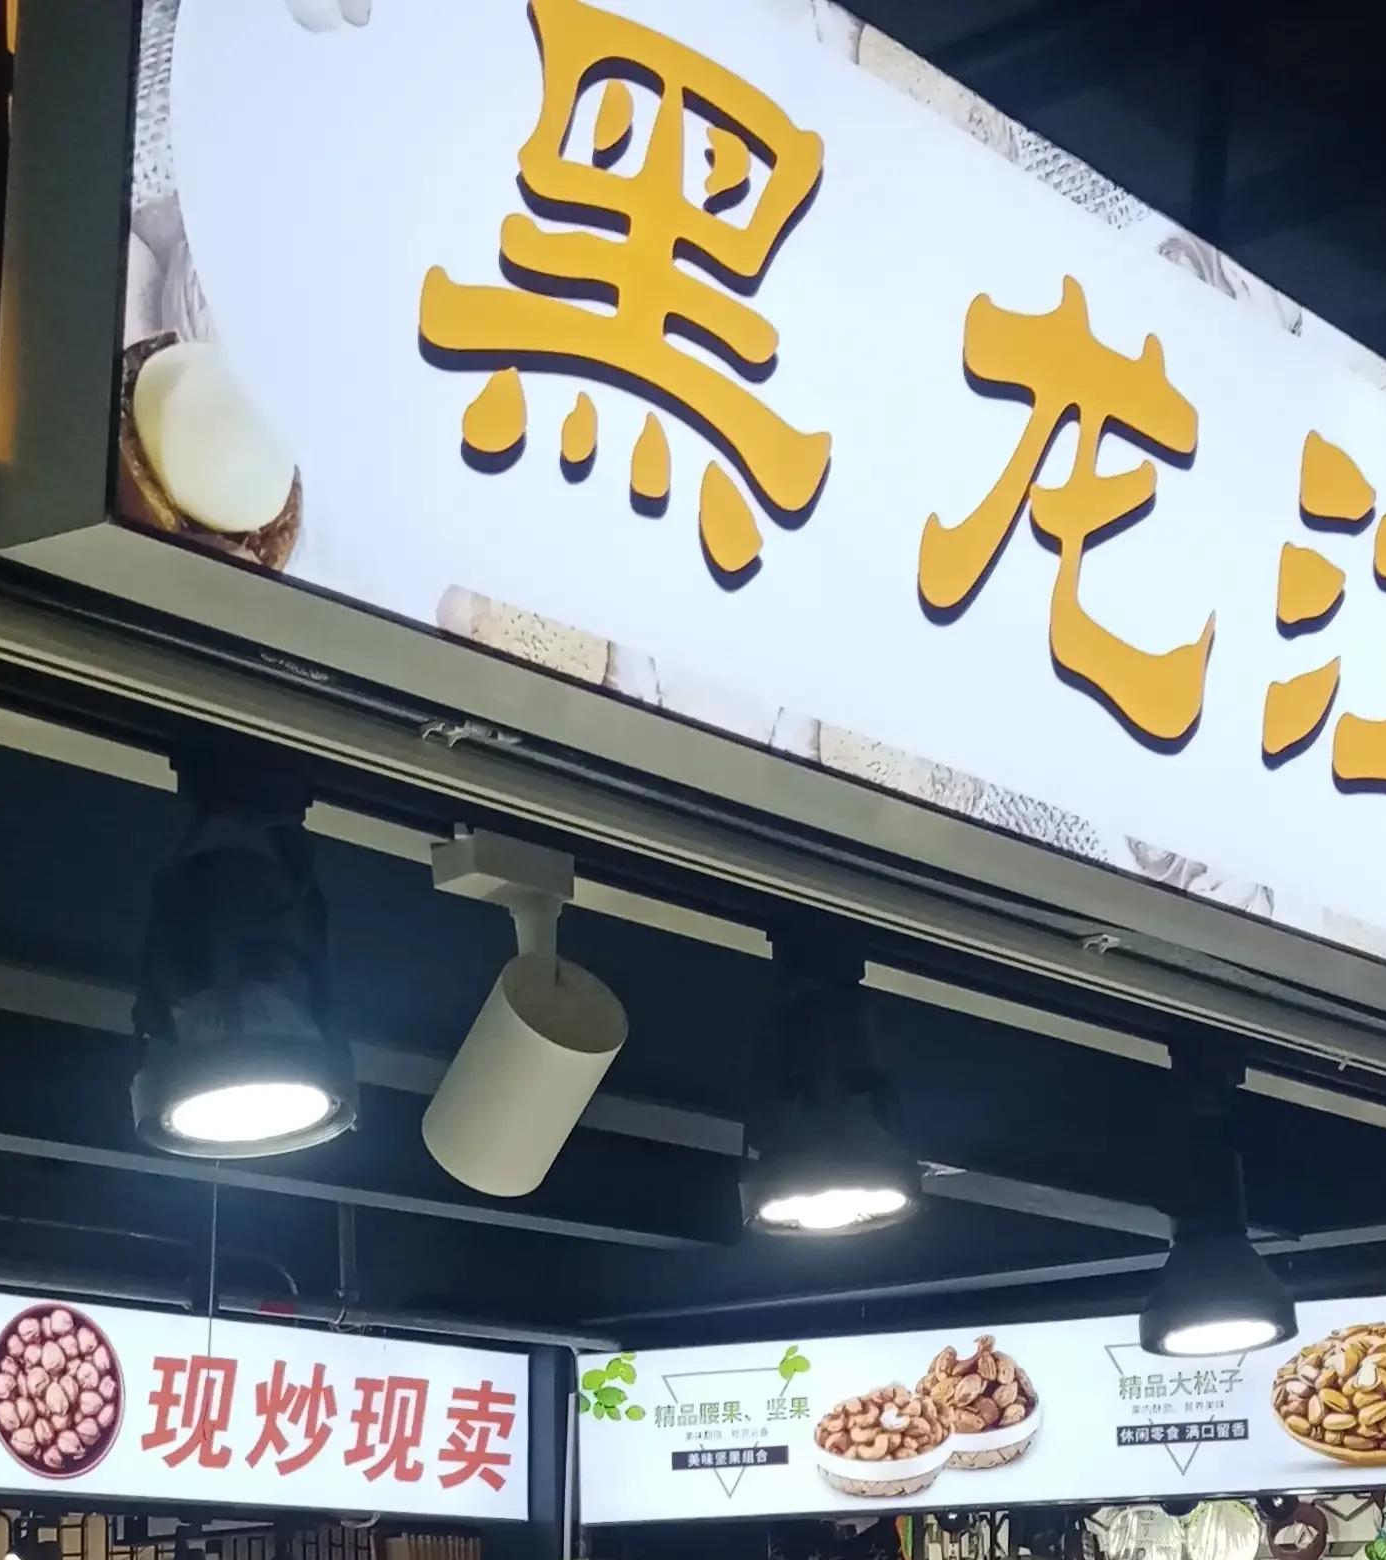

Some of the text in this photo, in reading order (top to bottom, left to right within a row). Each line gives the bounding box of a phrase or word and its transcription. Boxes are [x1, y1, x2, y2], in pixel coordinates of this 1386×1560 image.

[141, 1355, 517, 1492] 现炒现卖
[1119, 1369, 1243, 1400] 精品大松子
